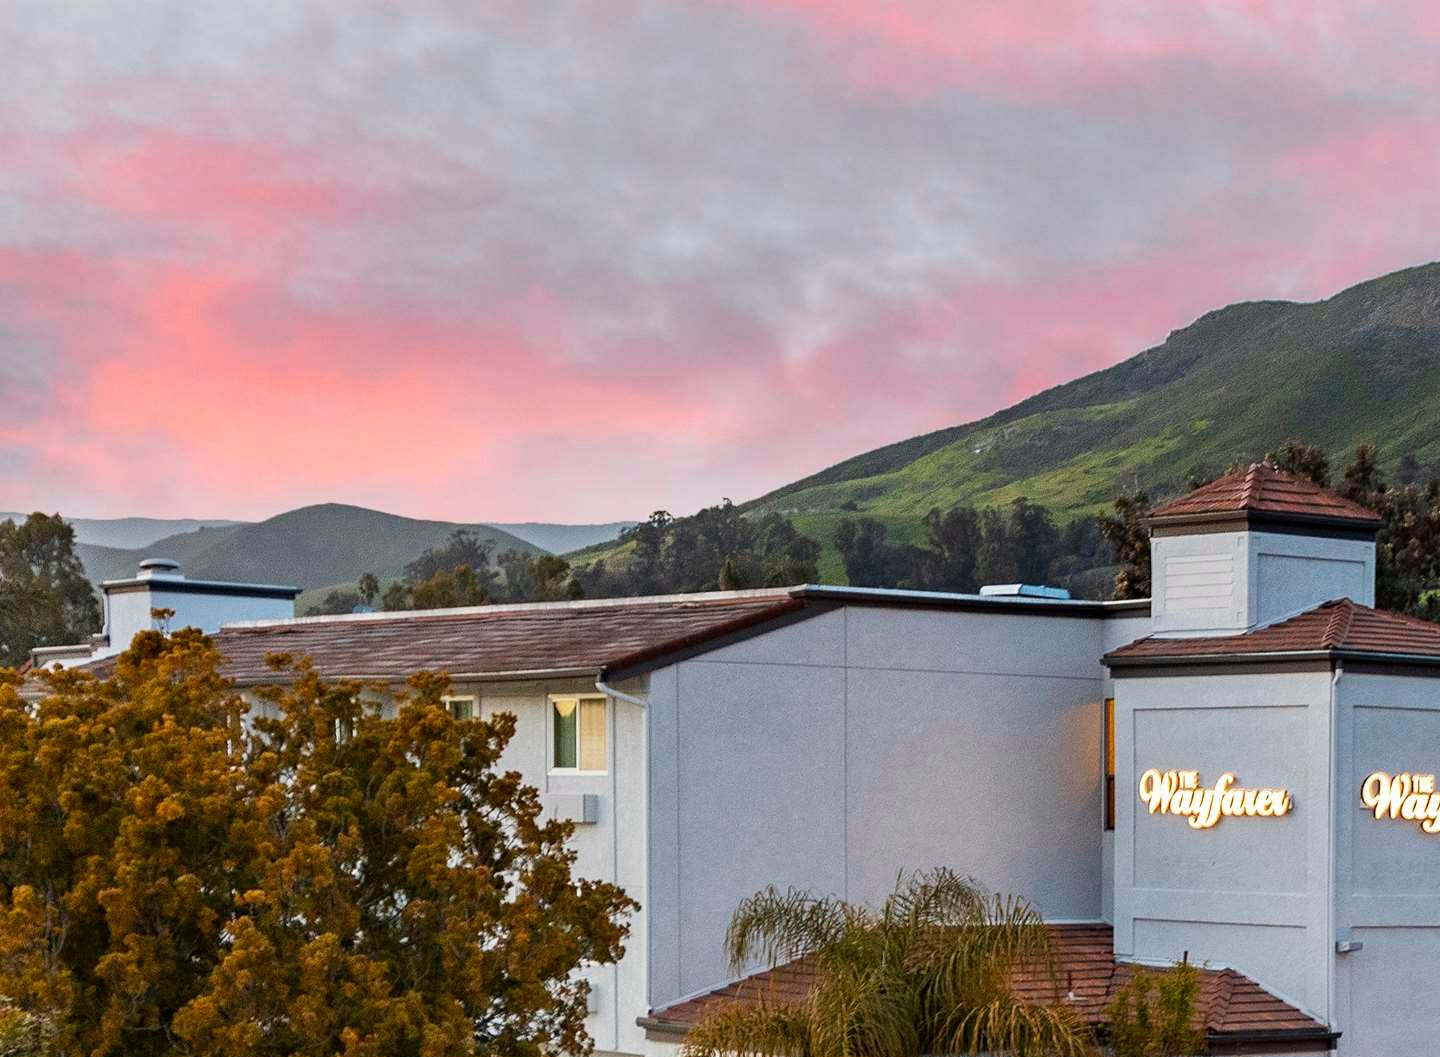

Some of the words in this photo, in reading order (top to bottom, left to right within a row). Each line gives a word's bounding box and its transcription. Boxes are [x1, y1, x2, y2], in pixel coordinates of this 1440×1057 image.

[1179, 771, 1199, 789] THE
[1412, 774, 1435, 793] THE
[1139, 768, 1290, 829] Wayfarer
